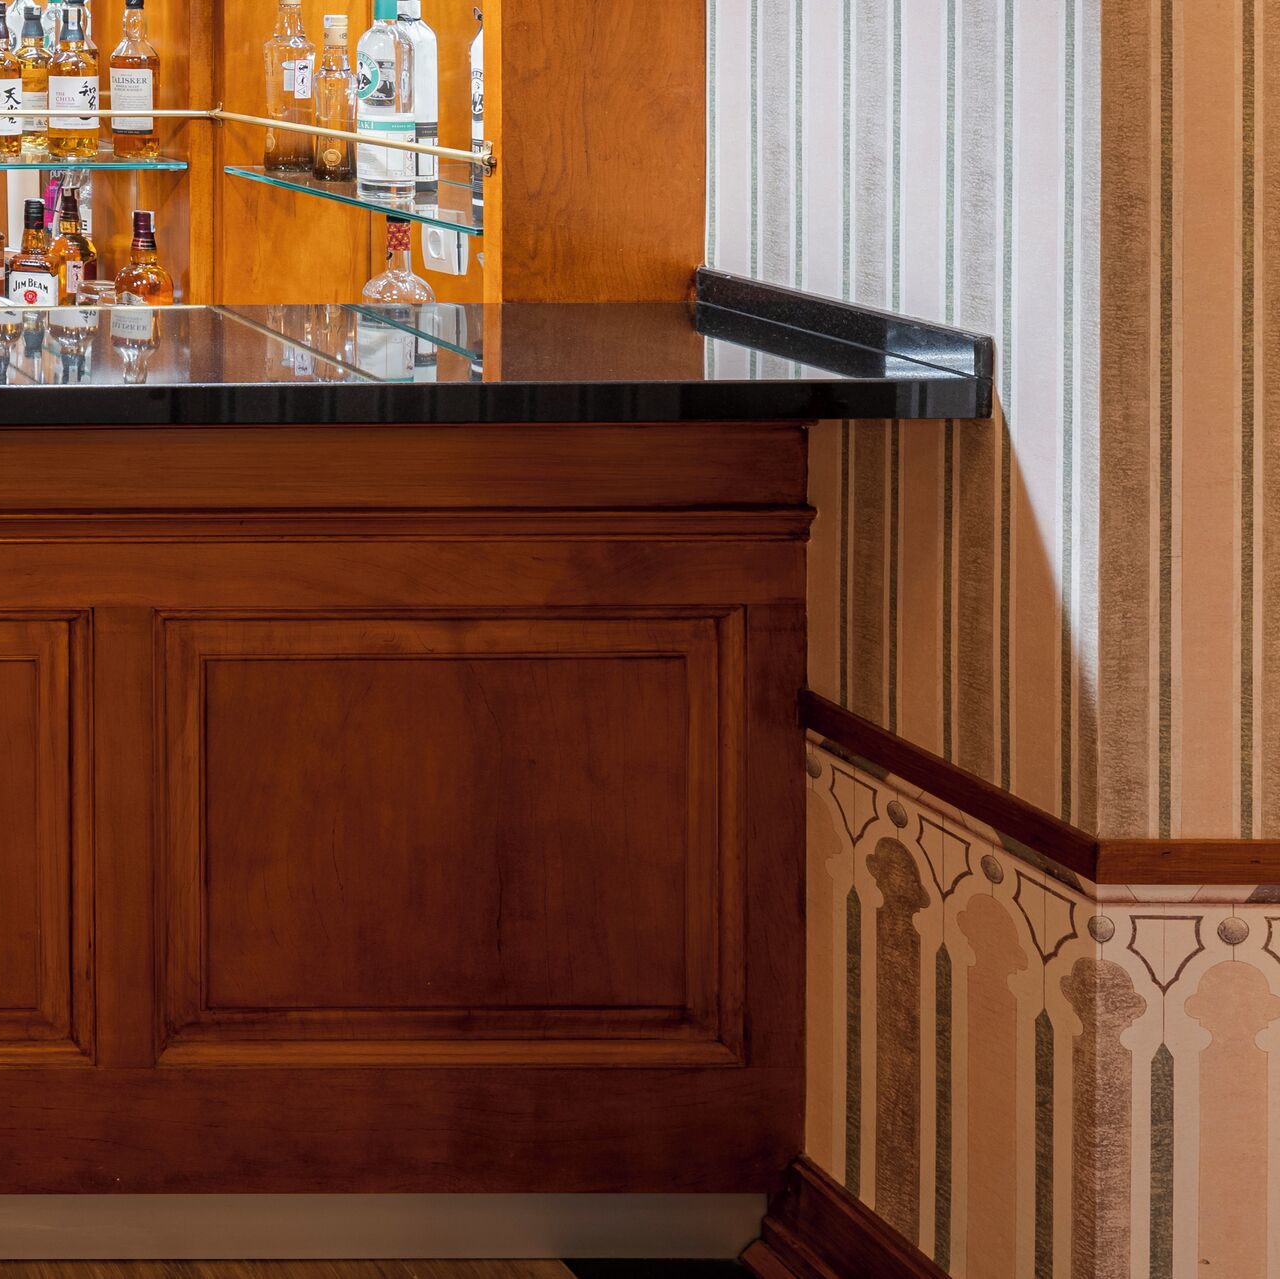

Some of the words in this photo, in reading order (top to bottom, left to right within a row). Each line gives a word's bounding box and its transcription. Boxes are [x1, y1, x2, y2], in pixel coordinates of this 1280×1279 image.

[111, 75, 148, 84] TALISKER
[13, 280, 27, 292] JIM
[28, 278, 48, 293] BEAM
